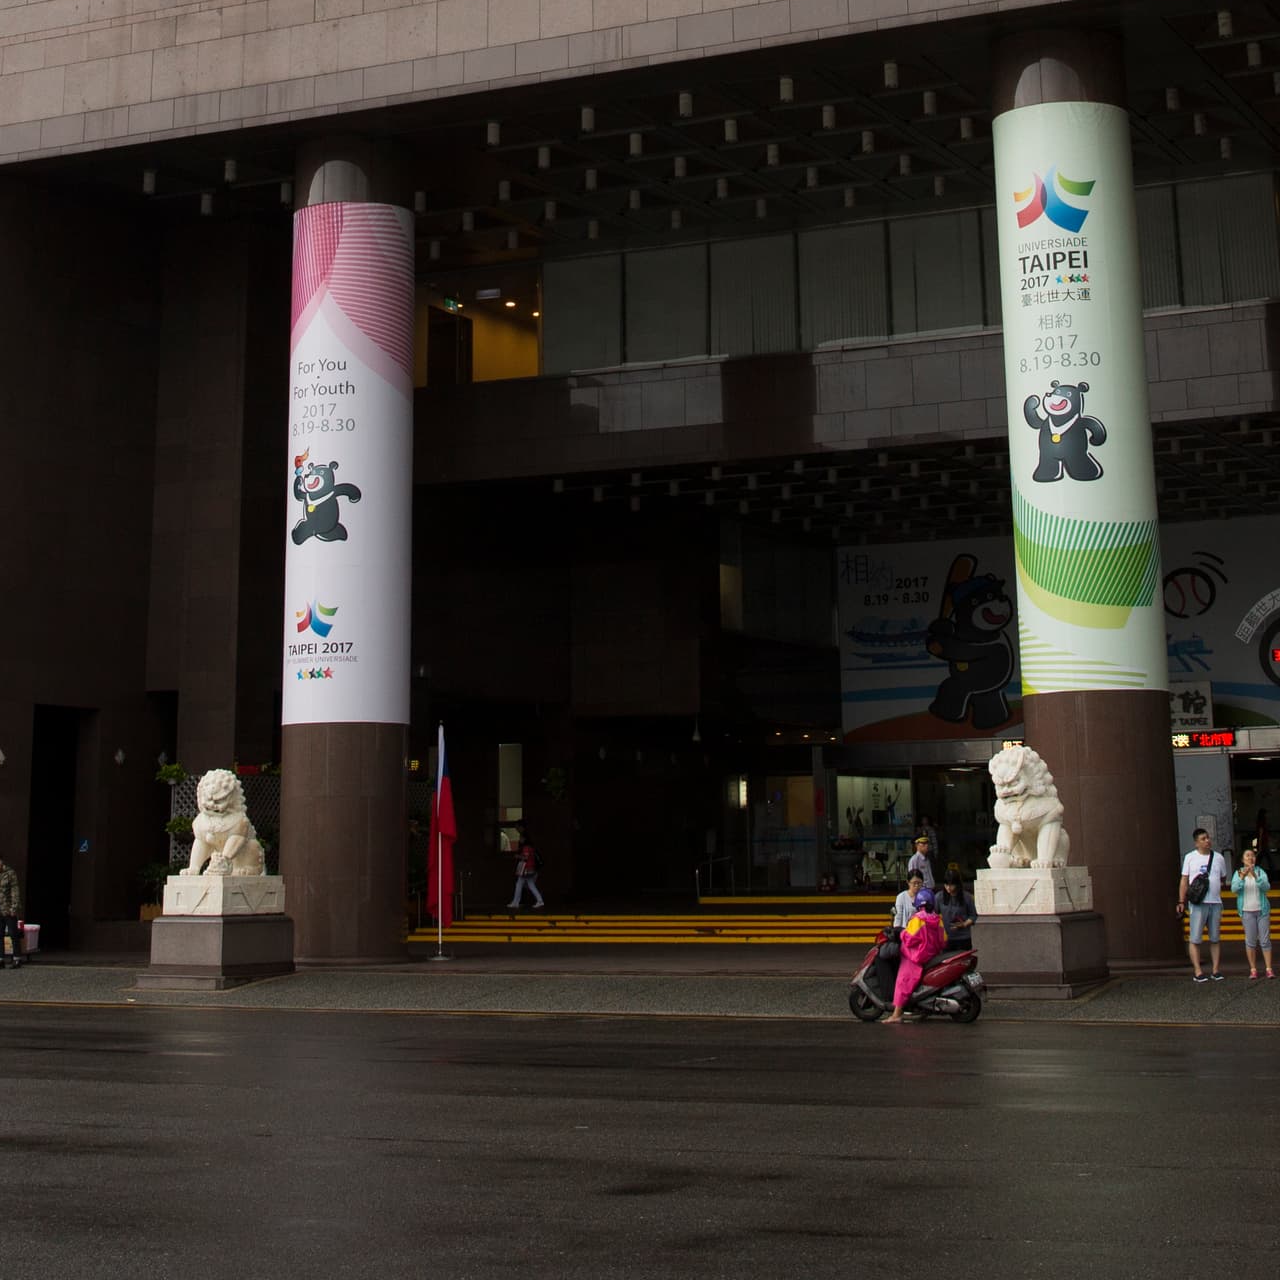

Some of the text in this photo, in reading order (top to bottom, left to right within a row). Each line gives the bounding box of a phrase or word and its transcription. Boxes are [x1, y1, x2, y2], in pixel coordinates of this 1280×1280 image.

[1017, 237, 1089, 254] UNIVERSIADE
[1018, 250, 1089, 275] TAIPEI
[1020, 274, 1050, 291] 2017
[1021, 287, 1092, 308] 臺北世大運
[1039, 312, 1073, 331] 相約
[1034, 334, 1079, 353] 2017
[297, 358, 348, 375] For You
[1019, 351, 1101, 373] 8.19-8.30
[293, 380, 356, 400] For Youth
[302, 403, 337, 419] 2017
[292, 418, 356, 437] 8.19-8.30
[895, 576, 929, 589] 2017
[288, 642, 354, 656] TAIPEI 2017
